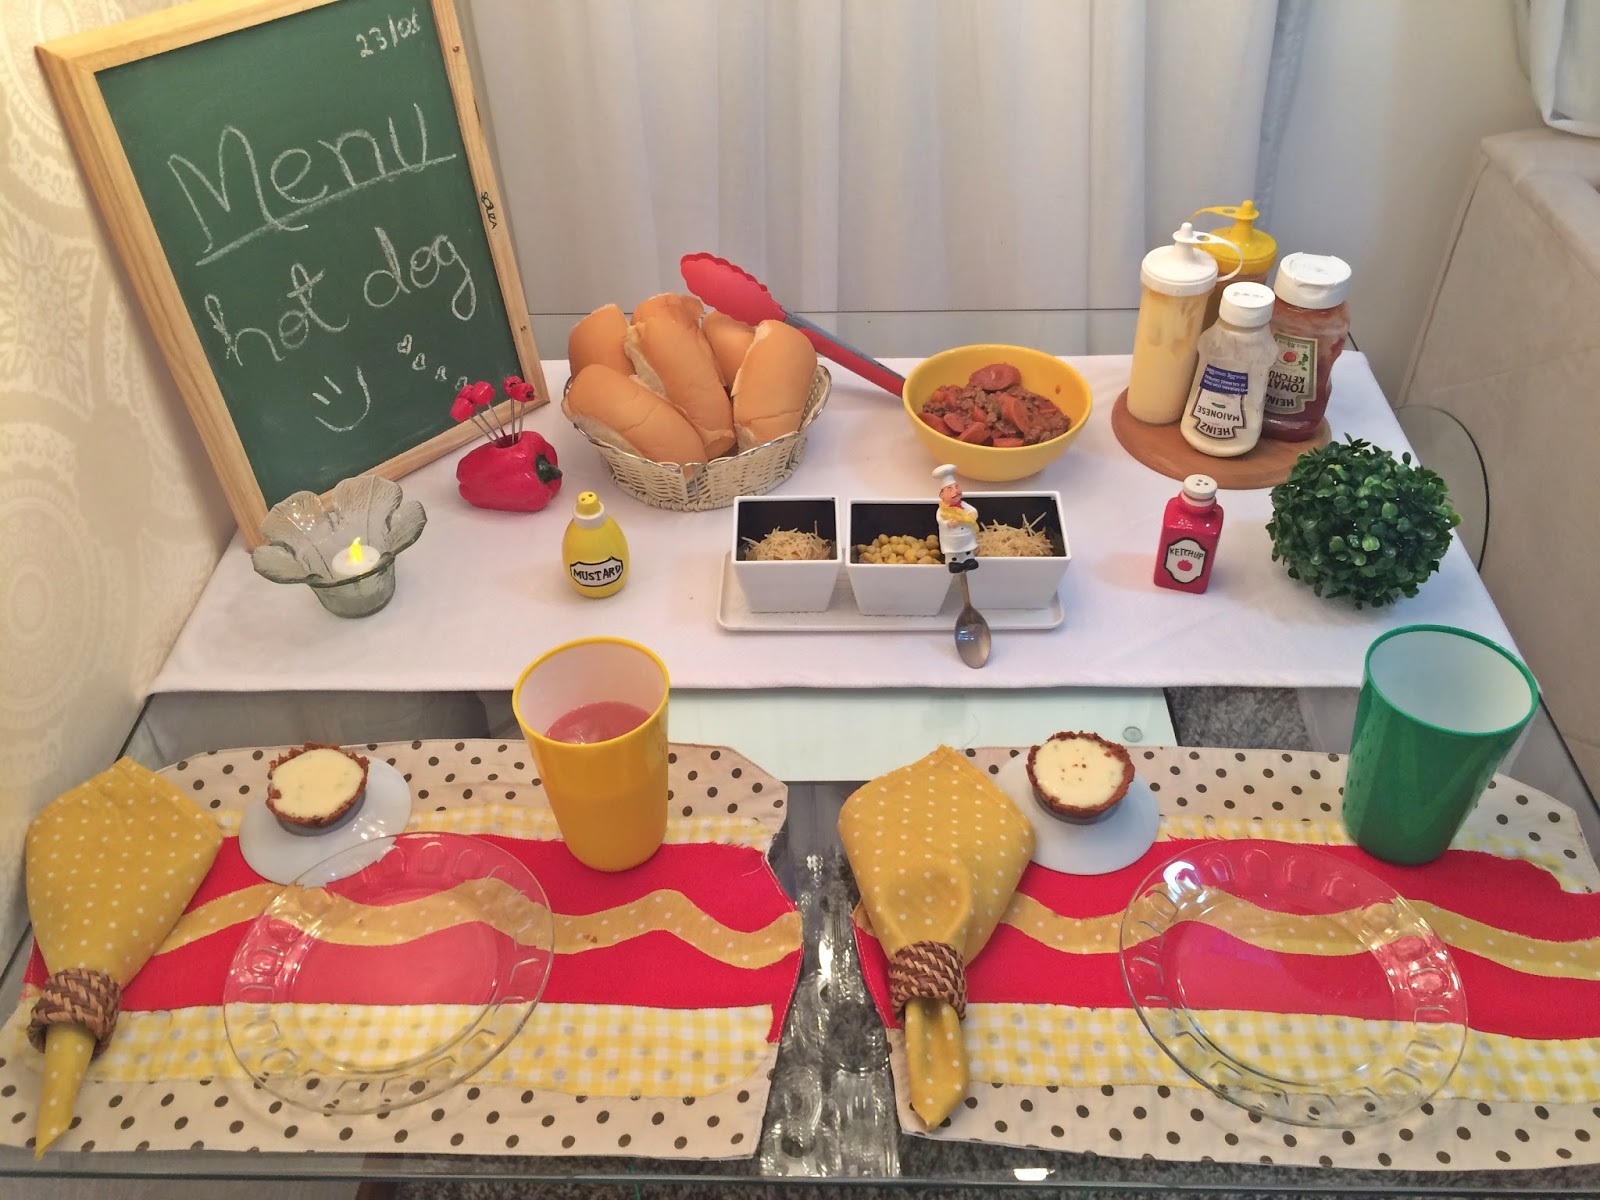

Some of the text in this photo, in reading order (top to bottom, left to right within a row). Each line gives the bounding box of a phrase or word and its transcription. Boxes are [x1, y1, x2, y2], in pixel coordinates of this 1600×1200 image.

[167, 102, 427, 253] Menu
[204, 226, 477, 366] hot dog
[1268, 370, 1306, 384] KETCHU
[1267, 378, 1305, 394] TOMAT
[1197, 405, 1240, 422] MAIONESE
[1200, 421, 1231, 436] HEINZ
[1169, 547, 1204, 560] KETCHUP
[573, 564, 621, 581] MUSTARD
